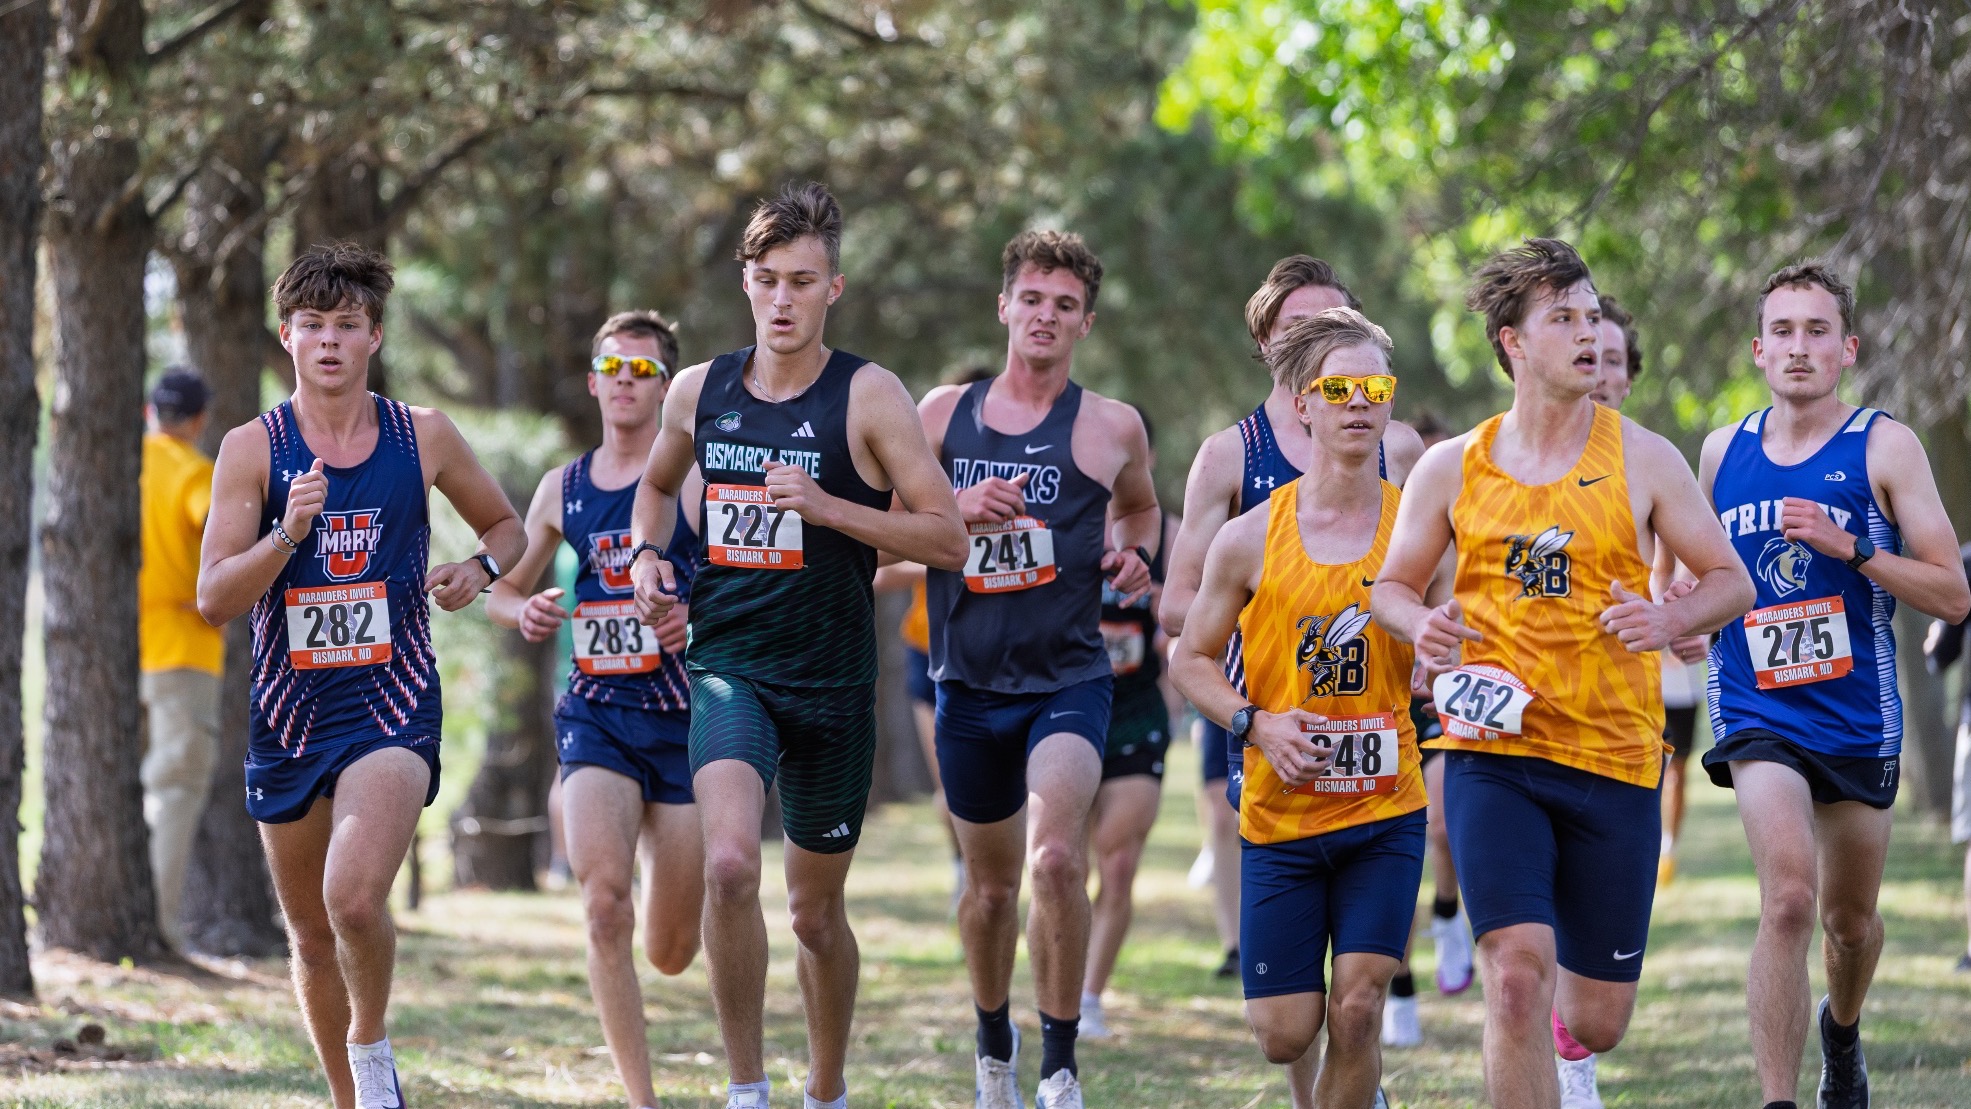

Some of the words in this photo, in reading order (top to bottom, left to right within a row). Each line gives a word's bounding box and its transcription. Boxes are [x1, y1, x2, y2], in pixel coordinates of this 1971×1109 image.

[705, 442, 773, 473] BISMARCK
[779, 449, 821, 479] STATE
[718, 488, 763, 502] MARAUDERS
[721, 502, 786, 548] 227
[1014, 518, 1040, 530] INVITE
[1720, 499, 1851, 540] TRIY
[320, 527, 379, 555] MARY
[326, 510, 378, 580] U
[974, 531, 1038, 574] 241
[589, 546, 632, 571] MAR
[726, 549, 767, 565] BISMARK,
[769, 552, 782, 564] ND
[983, 575, 1024, 589] BISMARK,
[1026, 570, 1038, 583] ND
[1540, 550, 1572, 598] B
[298, 588, 347, 604] MARAUDERS
[349, 586, 376, 600] INVITE
[303, 601, 376, 649] 282
[1756, 606, 1805, 625] MARAUDERS
[1806, 601, 1832, 615] INVITE
[585, 616, 643, 656] 283
[1762, 616, 1834, 668] 275
[312, 649, 357, 664] BISMARK,
[359, 647, 372, 661] ND
[592, 658, 628, 671] BISMARK,
[630, 656, 643, 669] ND
[1333, 633, 1370, 697] B
[1774, 666, 1818, 684] BISMARK,
[1819, 661, 1833, 675] ND
[1444, 673, 1514, 730] 252
[1360, 717, 1385, 730] INVITE
[1314, 779, 1360, 793] BISMARK,
[1362, 778, 1376, 791] ND
